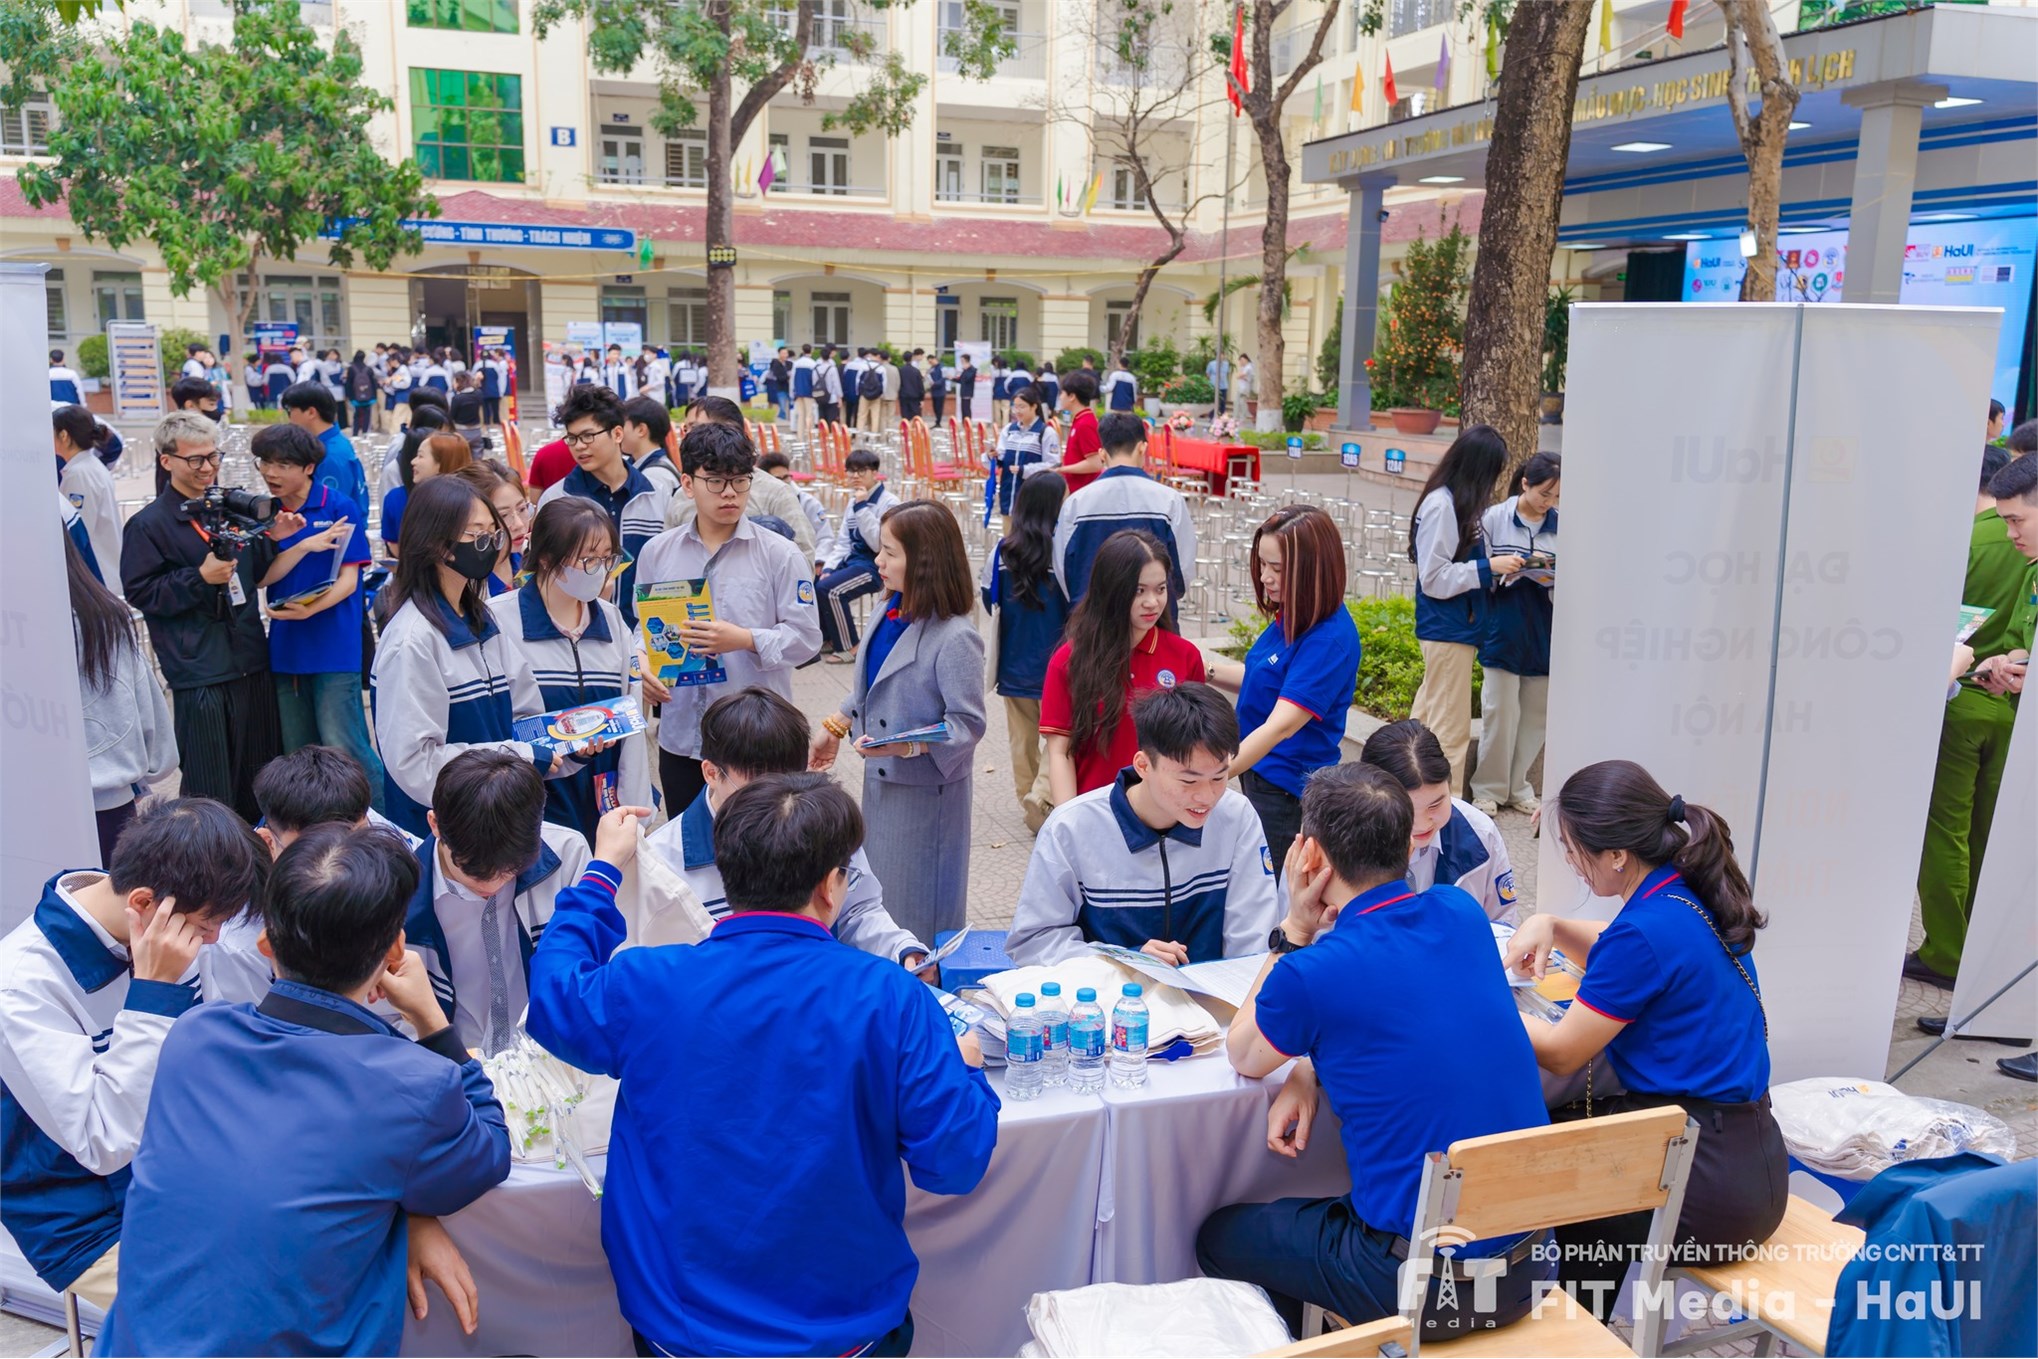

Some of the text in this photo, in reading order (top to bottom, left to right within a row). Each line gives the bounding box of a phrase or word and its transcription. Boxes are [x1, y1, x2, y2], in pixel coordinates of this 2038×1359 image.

[1654, 78, 1686, 111] HỌC
[1806, 49, 1857, 89] LỊCH
[556, 128, 571, 145] B
[1943, 244, 1974, 258] HaUI
